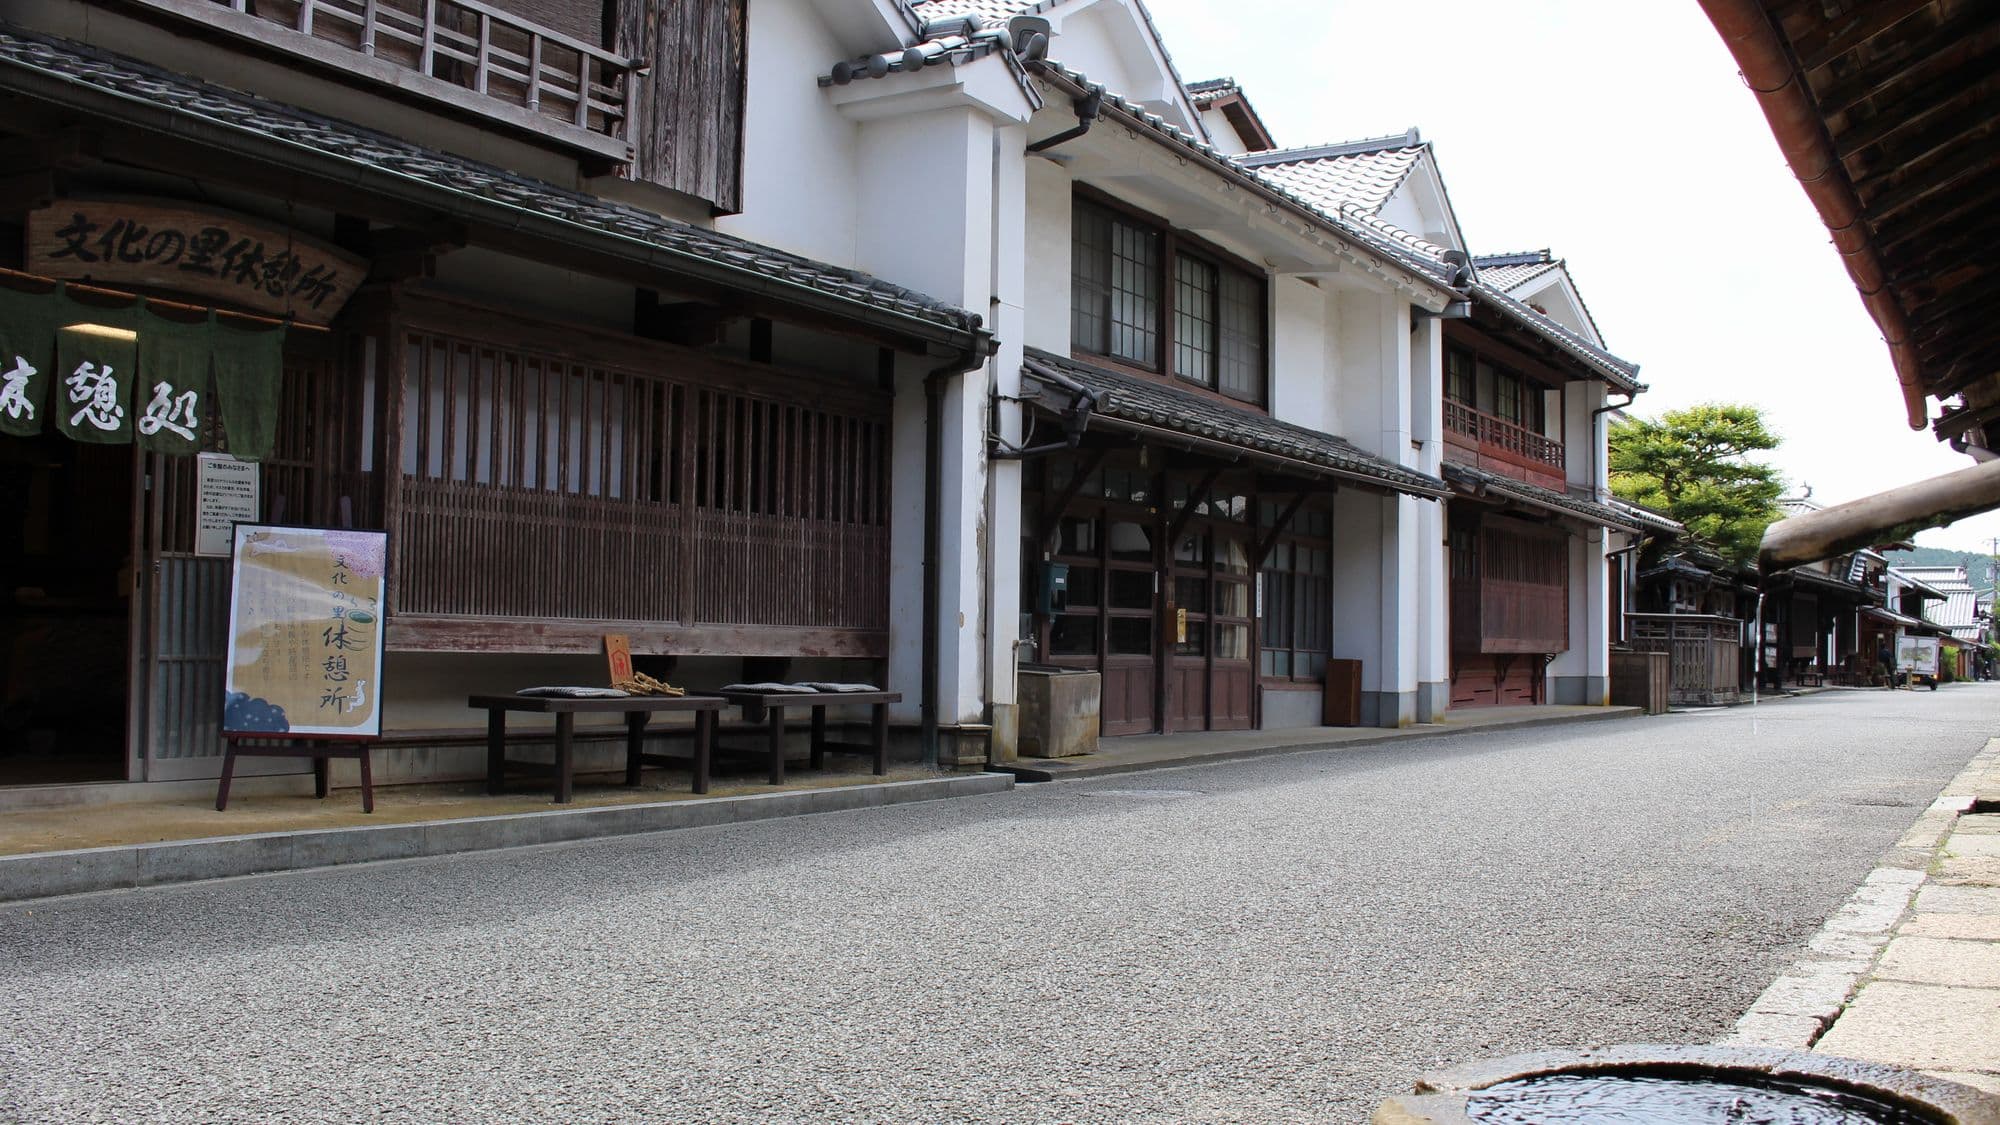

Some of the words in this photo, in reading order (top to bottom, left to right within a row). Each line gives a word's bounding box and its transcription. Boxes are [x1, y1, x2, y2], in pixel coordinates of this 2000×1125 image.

[50, 212, 338, 309] 文化の里休憩所
[320, 555, 351, 715] 文化の里休憩所
